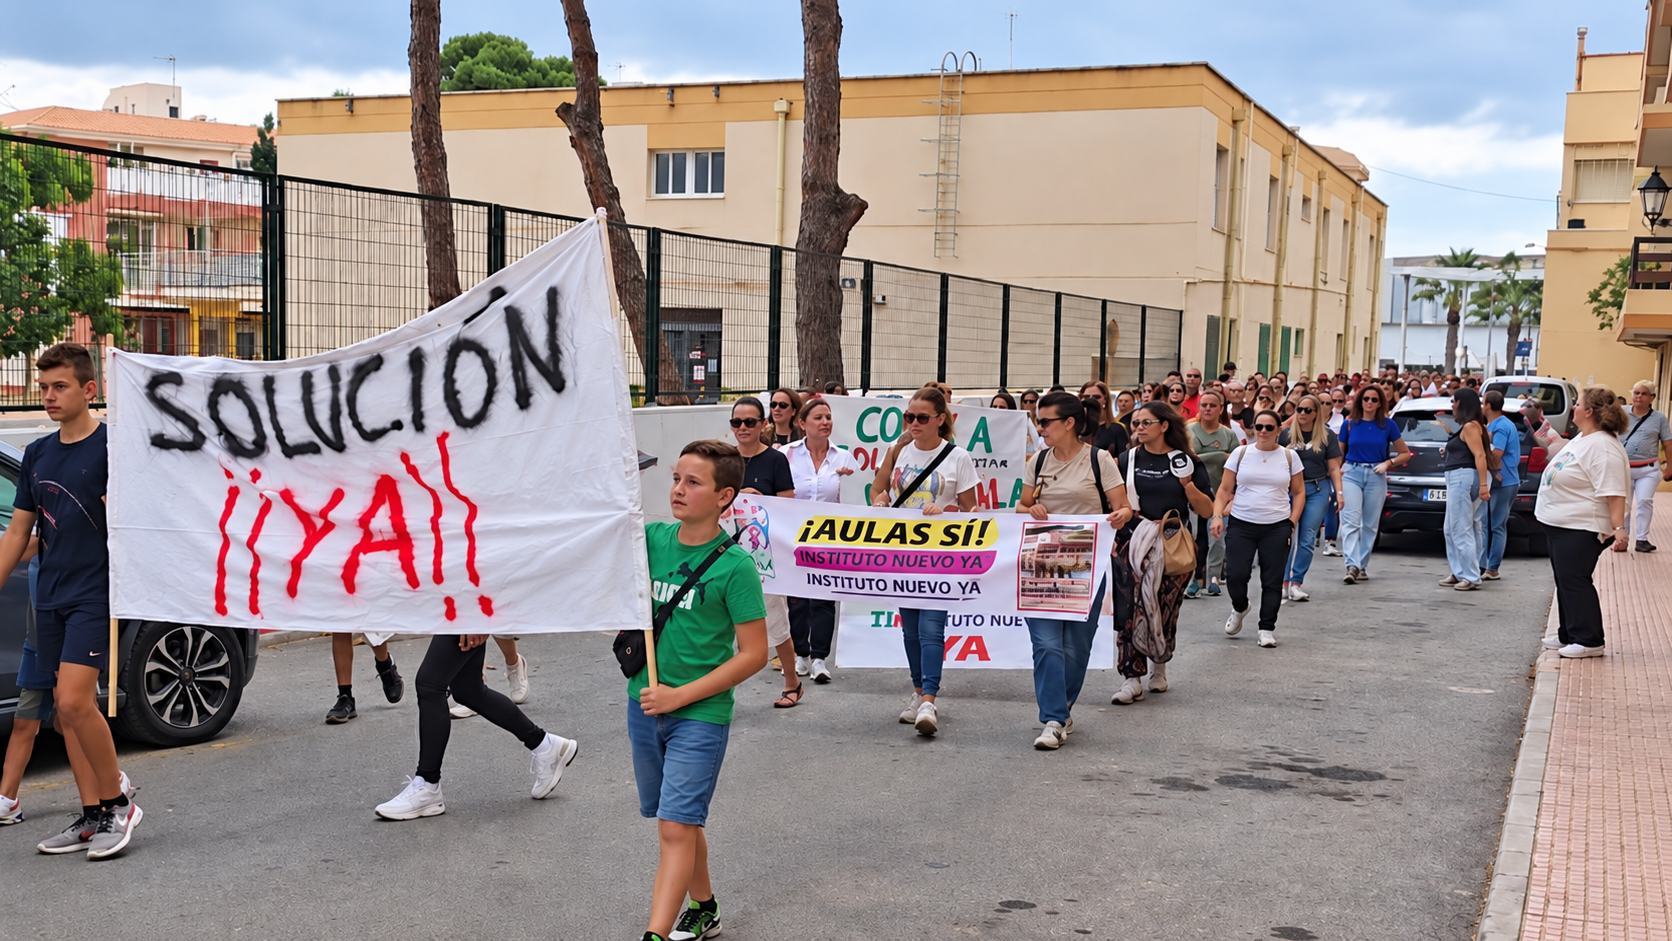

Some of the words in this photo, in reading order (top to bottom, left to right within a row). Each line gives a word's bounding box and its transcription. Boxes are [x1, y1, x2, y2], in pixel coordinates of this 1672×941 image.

[144, 286, 568, 459] SOLUCIÓN
[798, 519, 931, 545] ¡AULAS
[939, 517, 993, 546] SÍ!
[800, 550, 888, 567] INSTITUTO
[892, 554, 955, 569] NUEVO
[961, 555, 983, 569] YA
[807, 573, 888, 592] INSTITUTO
[893, 578, 951, 595] NUEVO
[957, 581, 982, 595] YA
